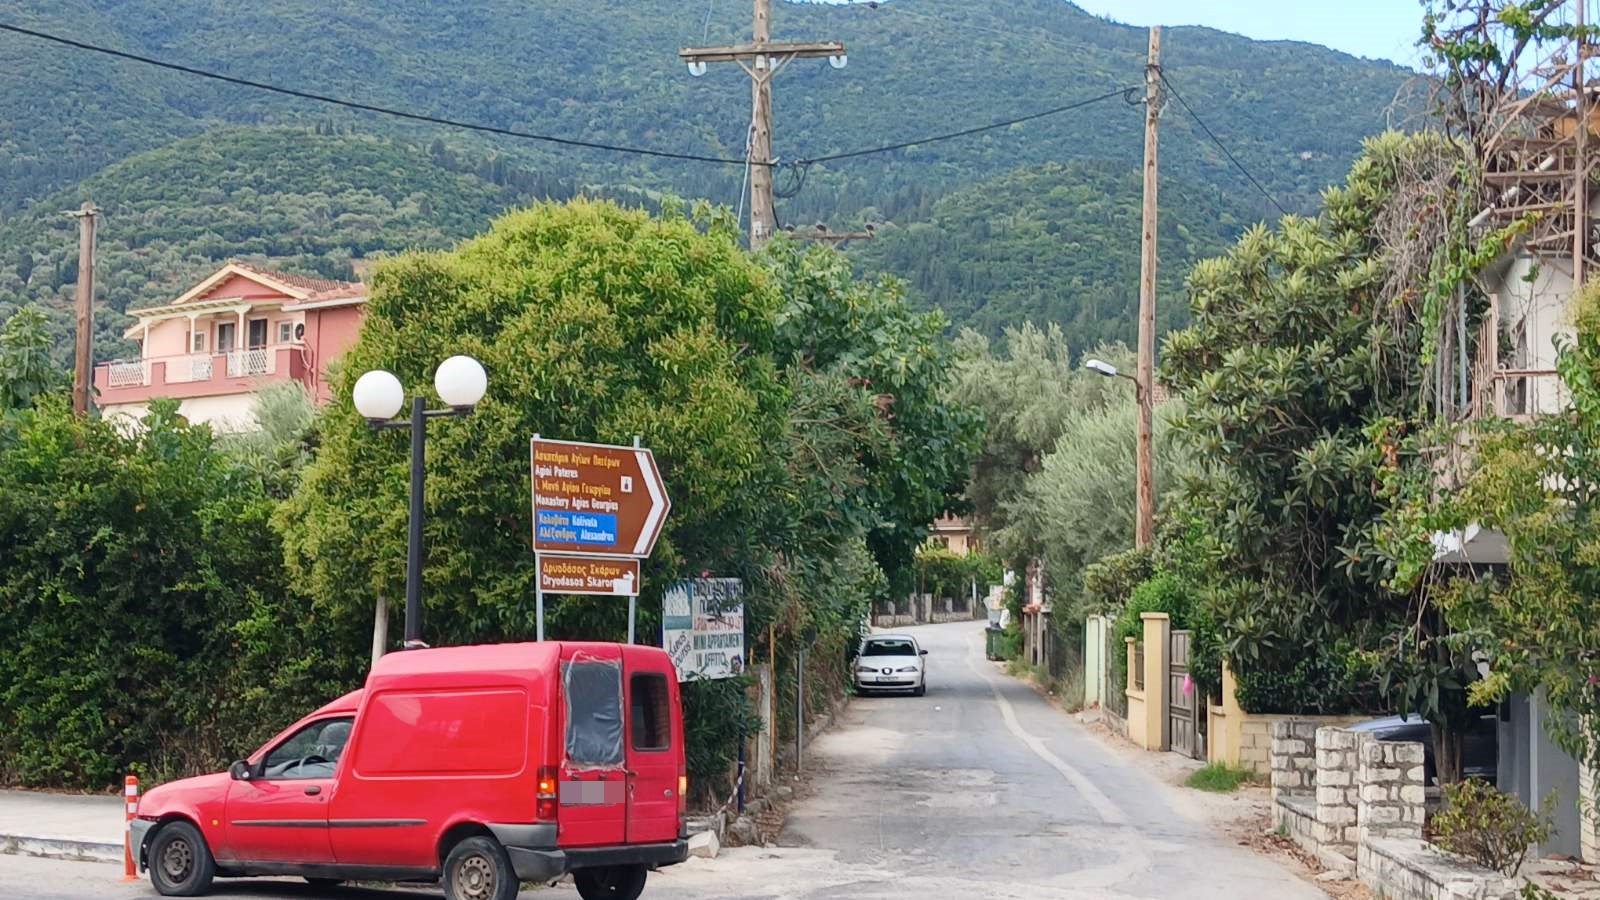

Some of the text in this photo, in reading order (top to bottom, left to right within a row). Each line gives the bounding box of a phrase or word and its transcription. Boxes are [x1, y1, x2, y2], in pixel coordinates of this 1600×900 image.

[554, 465, 579, 478] Pateres
[535, 494, 619, 512] Monastery Agios Georgios
[580, 529, 615, 542] Alexandros
[543, 562, 620, 577] Δρυοδάσος Σκάρων
[543, 574, 584, 588] Dryodasos
